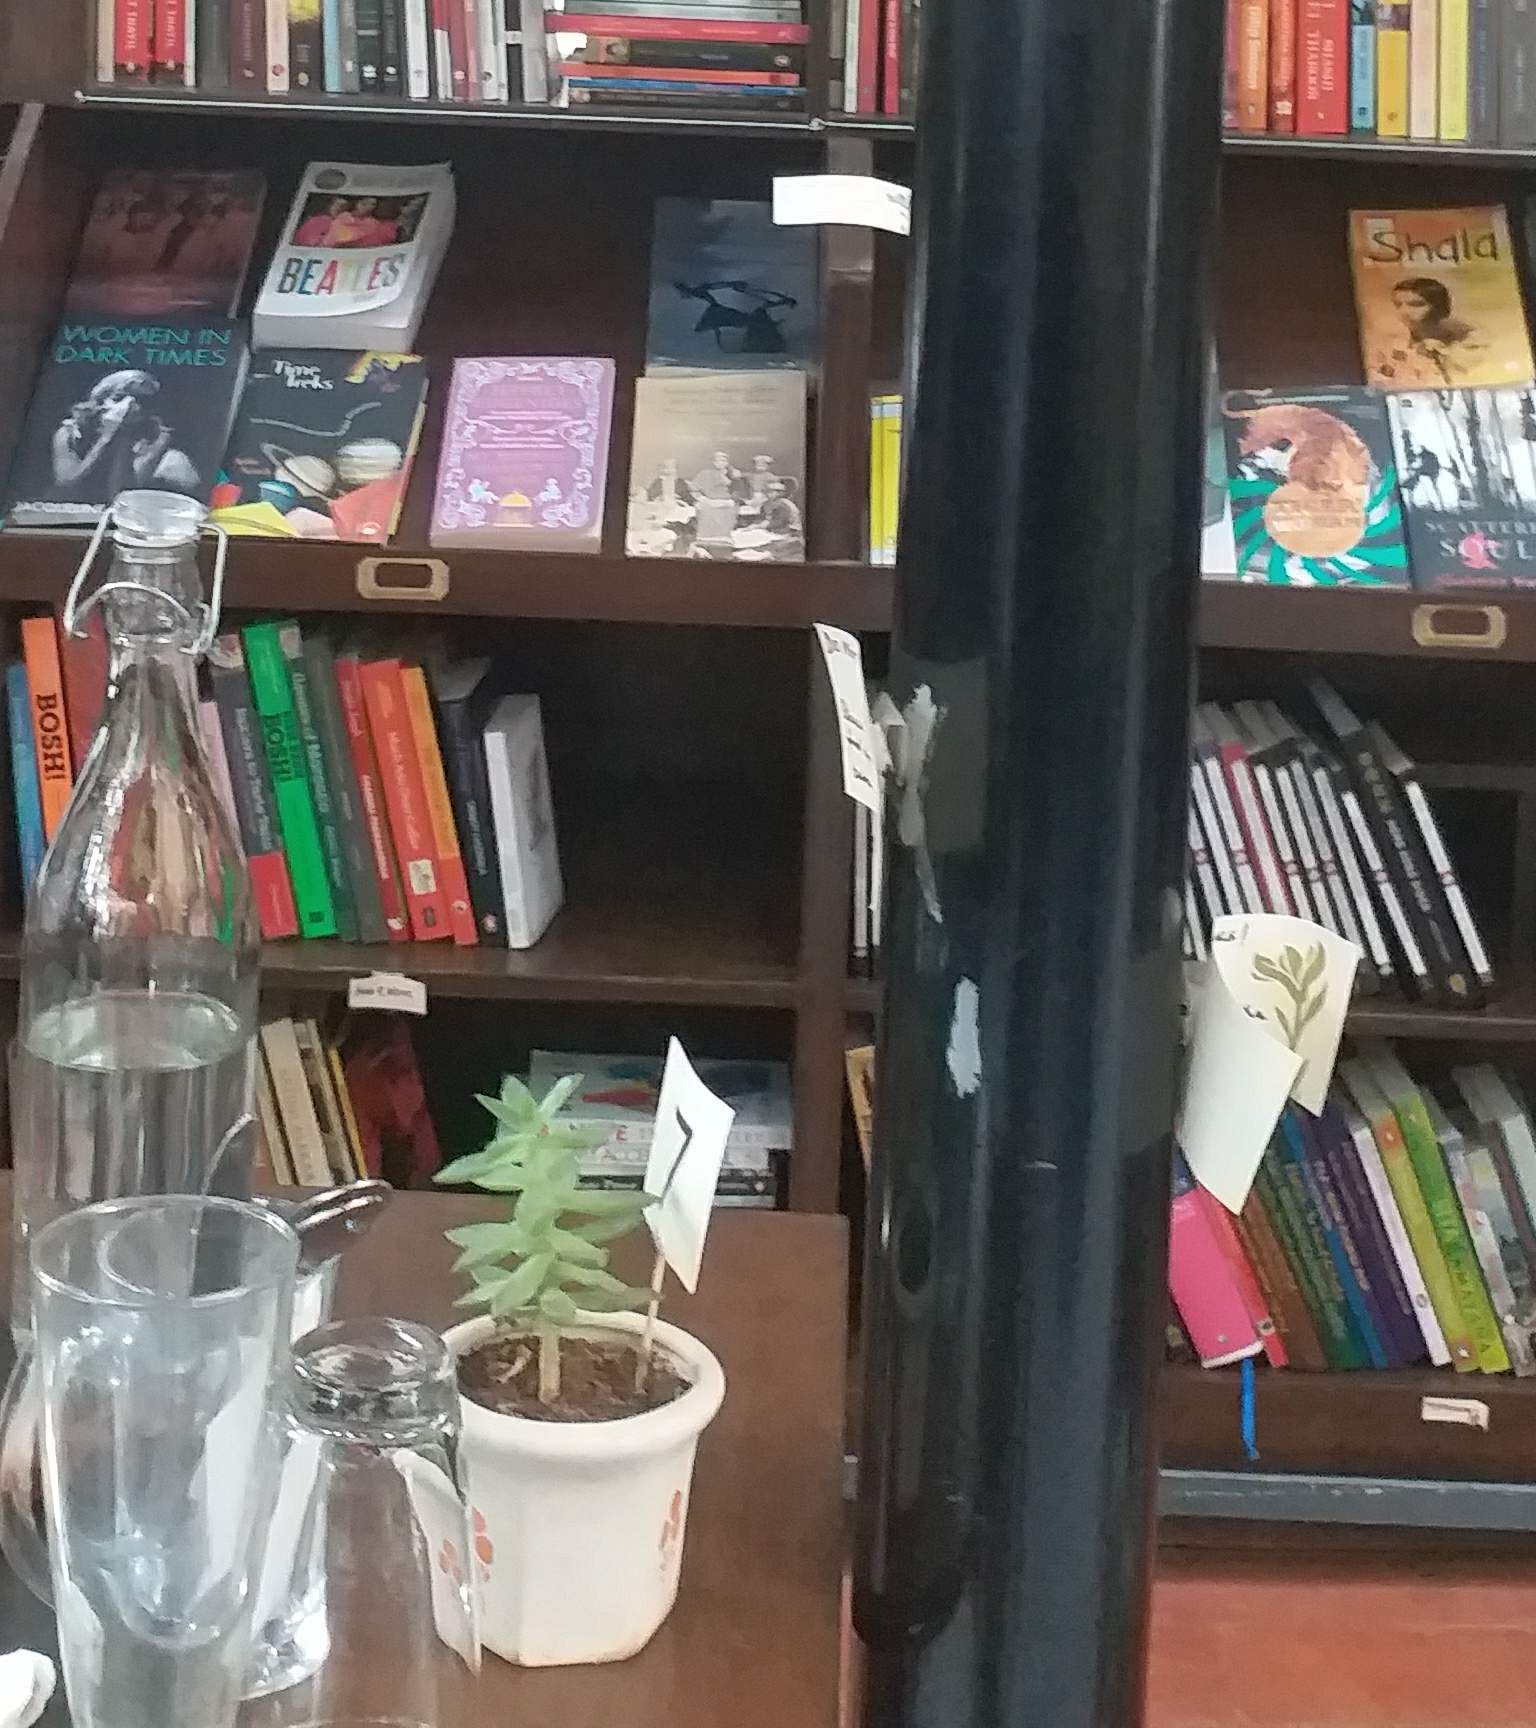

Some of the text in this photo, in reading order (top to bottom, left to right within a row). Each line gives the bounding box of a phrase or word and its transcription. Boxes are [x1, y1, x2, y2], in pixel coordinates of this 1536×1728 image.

[1367, 229, 1499, 264] Shala
[277, 252, 408, 296] BEATLES
[63, 325, 231, 346] WOMEN IN
[55, 345, 228, 367] DARK TIMES
[35, 691, 68, 782] BOSH!
